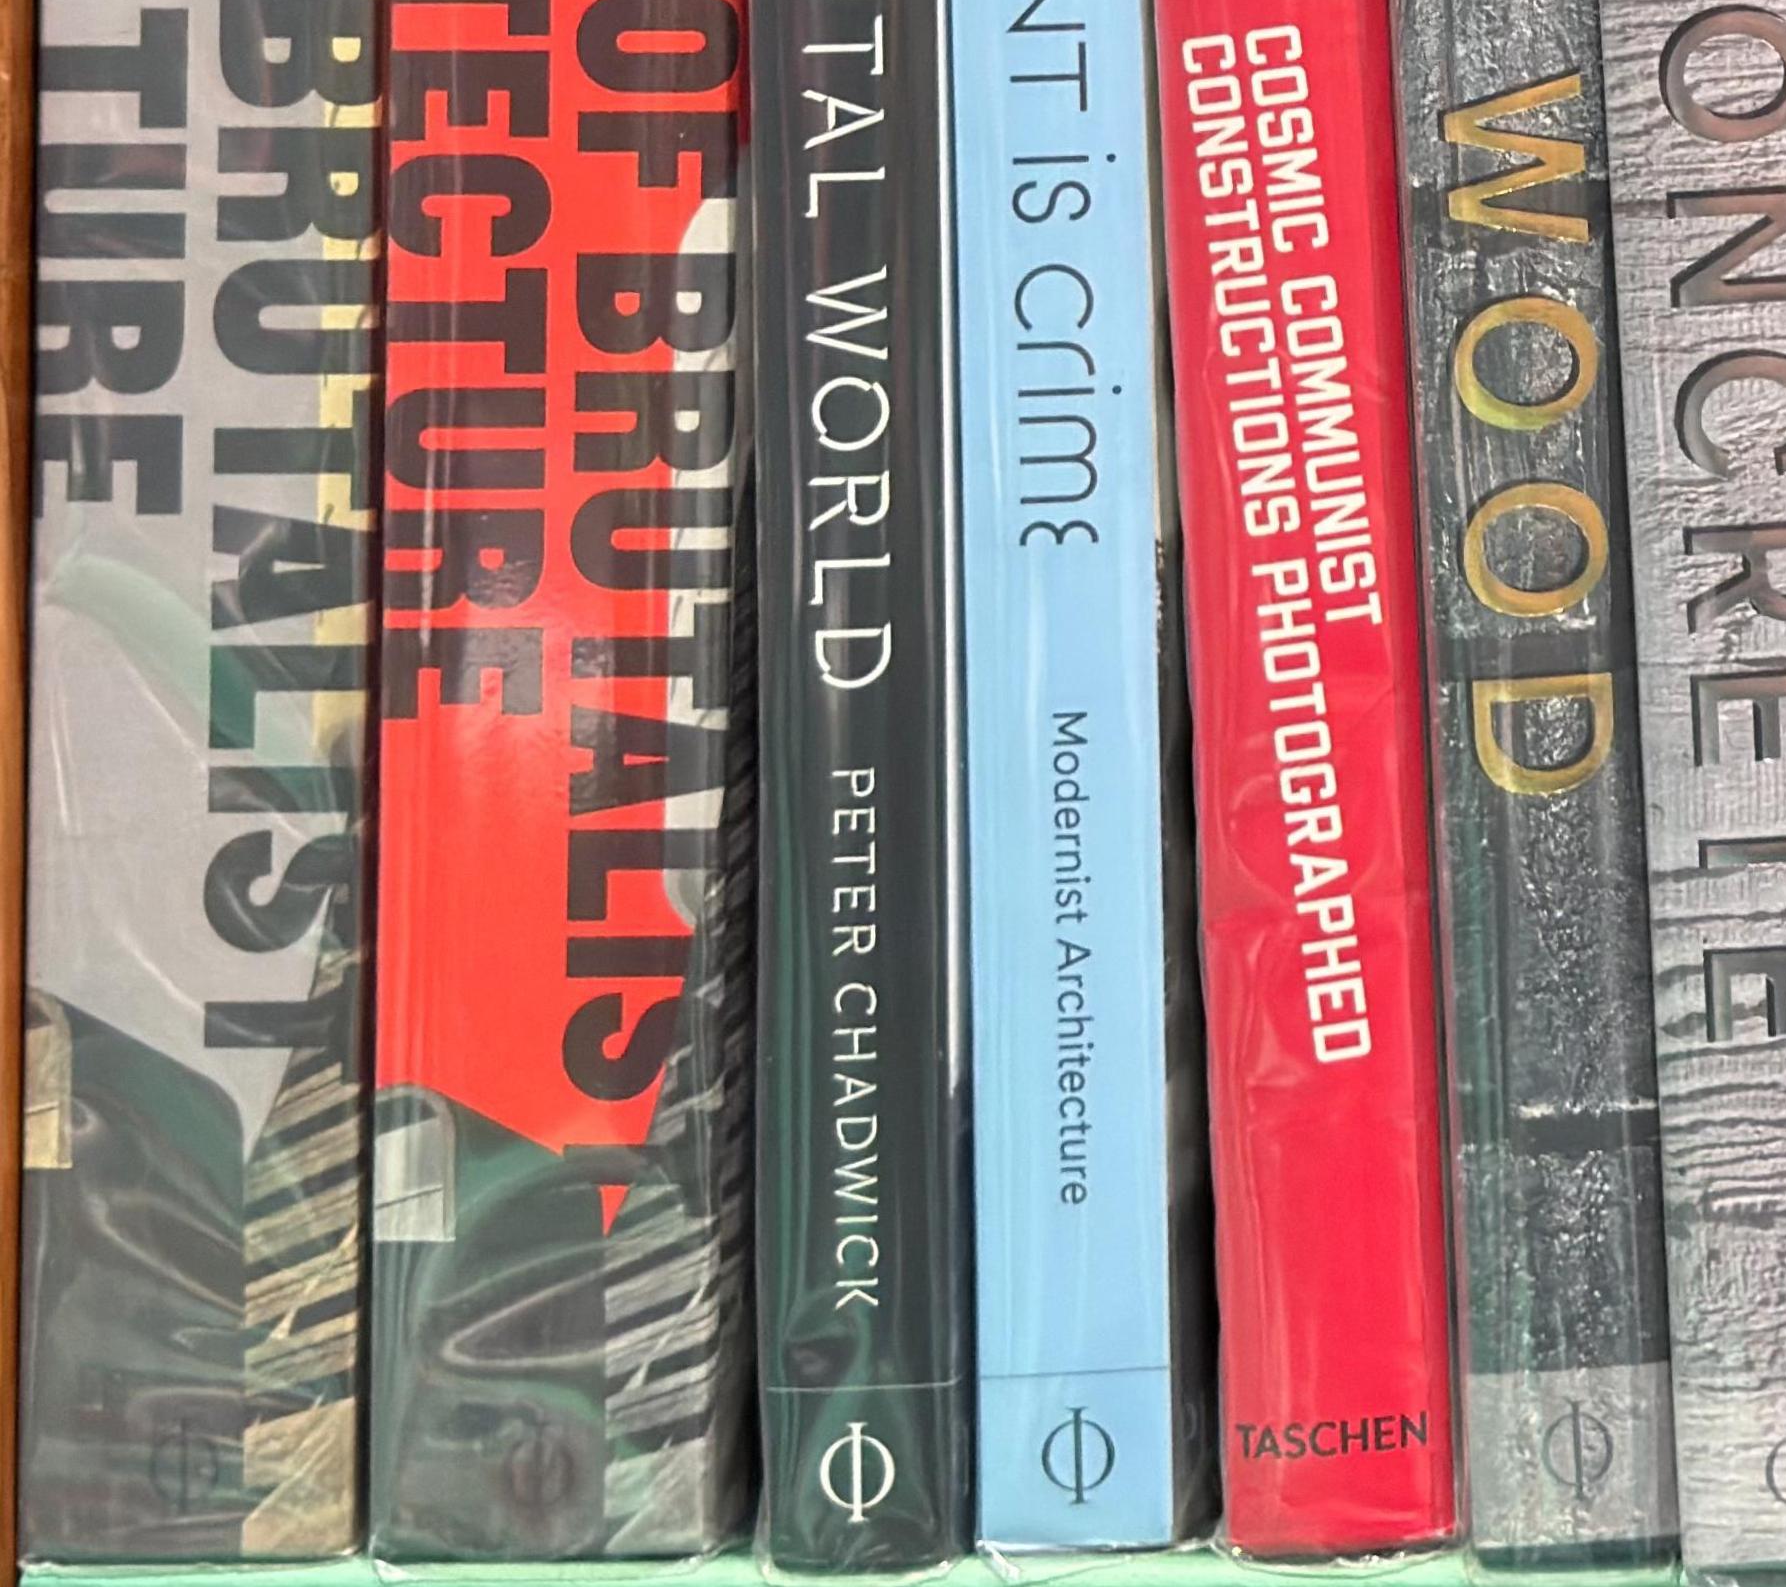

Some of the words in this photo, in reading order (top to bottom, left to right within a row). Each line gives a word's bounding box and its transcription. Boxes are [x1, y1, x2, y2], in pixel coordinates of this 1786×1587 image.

[1245, 24, 1329, 254] COSMIC
[804, 263, 892, 690] WORLD
[1181, 32, 1301, 538] CONSTRUCTIONS
[1251, 556, 1372, 1064] PHOTOGRAPHED
[1279, 274, 1383, 626] COMMUNIST
[1437, 72, 1615, 796] WOOD
[830, 766, 877, 957] PETER
[1051, 710, 1090, 926] Modernist
[832, 980, 879, 1310] CHADWICK
[1052, 937, 1093, 1206] Architecture
[1235, 1410, 1428, 1462] TASCHEN
